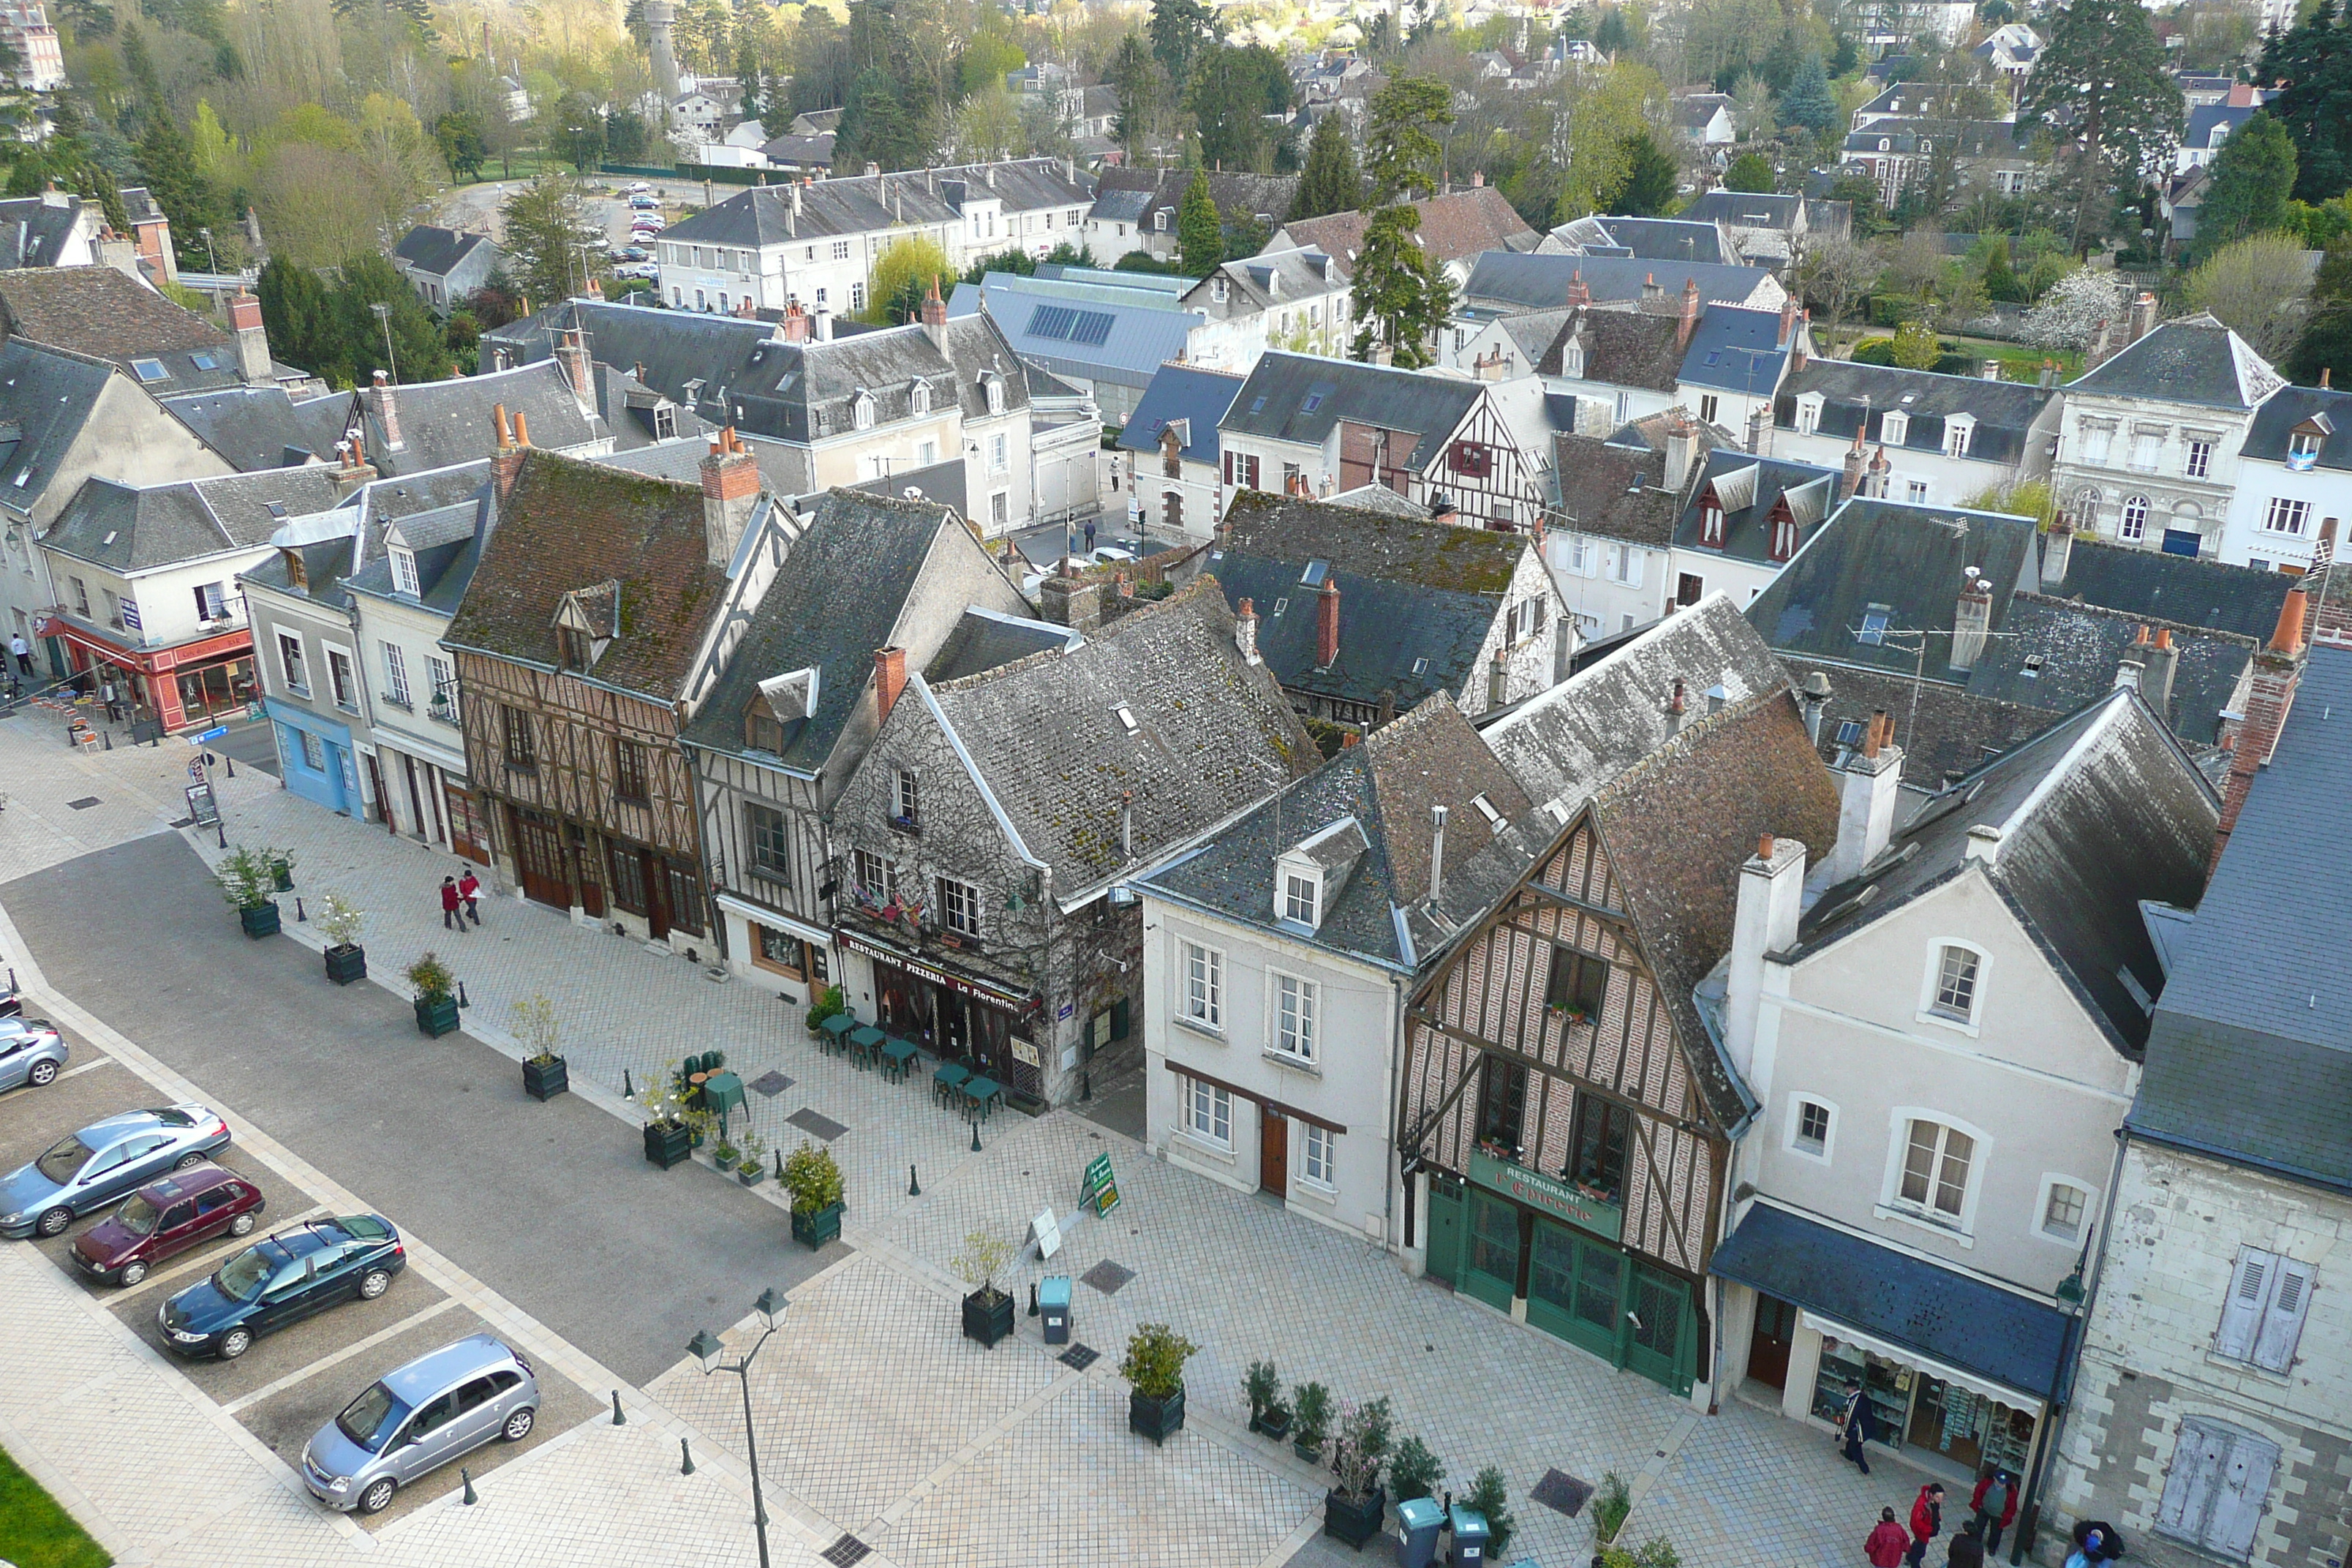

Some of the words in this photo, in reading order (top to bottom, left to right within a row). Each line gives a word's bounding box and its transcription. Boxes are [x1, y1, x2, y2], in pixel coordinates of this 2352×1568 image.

[848, 940, 902, 968] RESTAURANT
[906, 962, 946, 985] PIZZERIA
[957, 981, 968, 994] La
[1507, 1167, 1581, 1204] RESTAURANT
